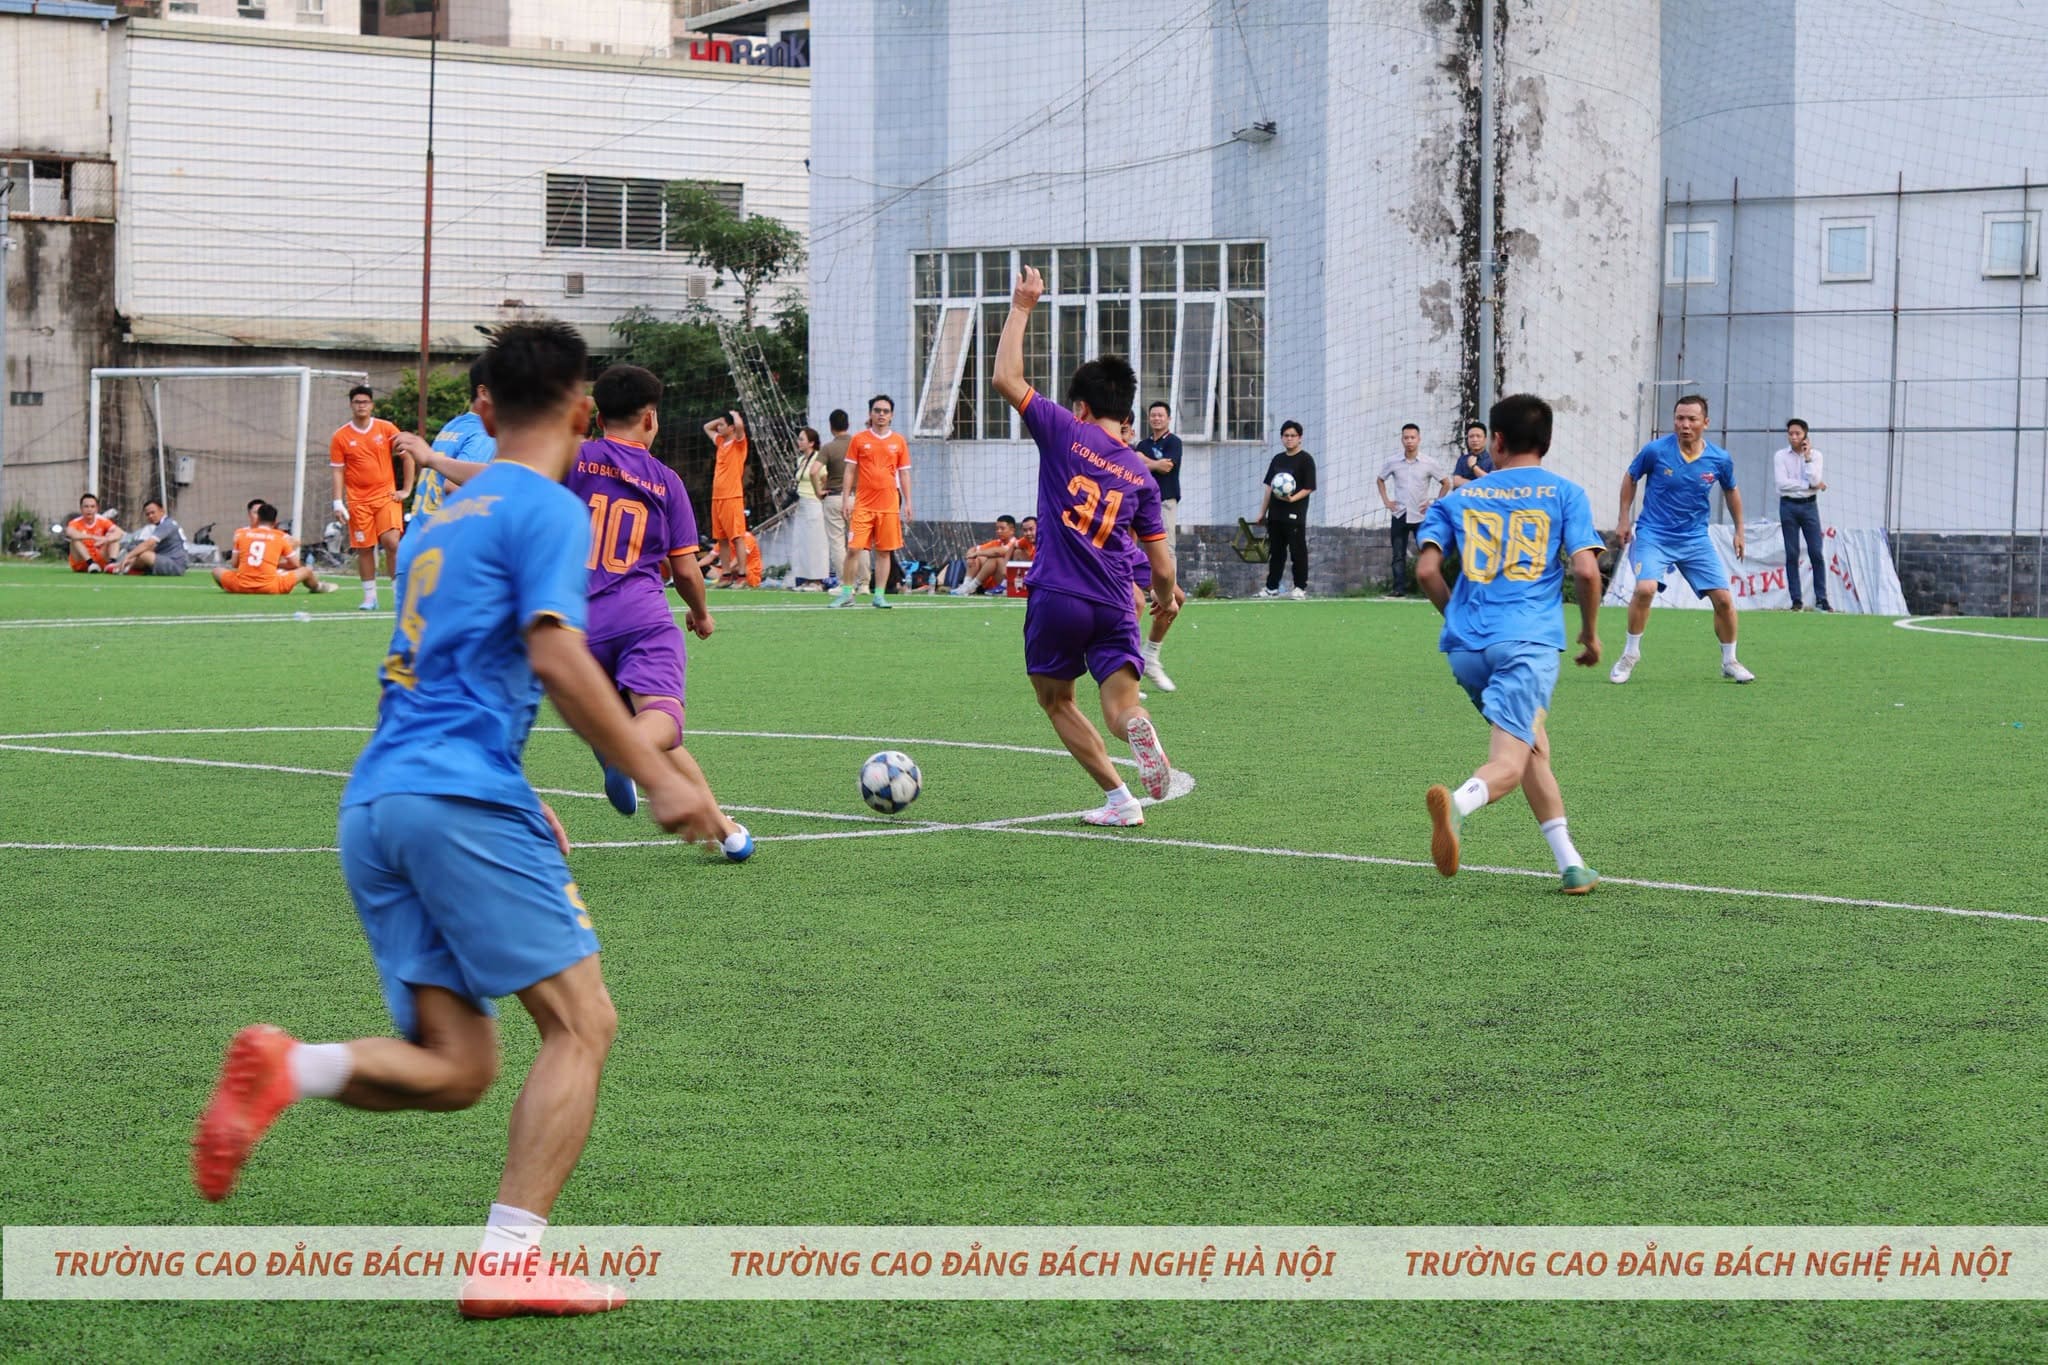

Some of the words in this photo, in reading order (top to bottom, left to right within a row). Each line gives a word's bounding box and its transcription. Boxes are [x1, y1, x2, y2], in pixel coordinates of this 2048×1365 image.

[1061, 474, 1124, 549] 31
[1460, 486, 1533, 501] HACINCO
[1536, 485, 1558, 499] FC
[246, 540, 266, 567] 9
[584, 492, 649, 575] 10
[1461, 509, 1552, 584] 88
